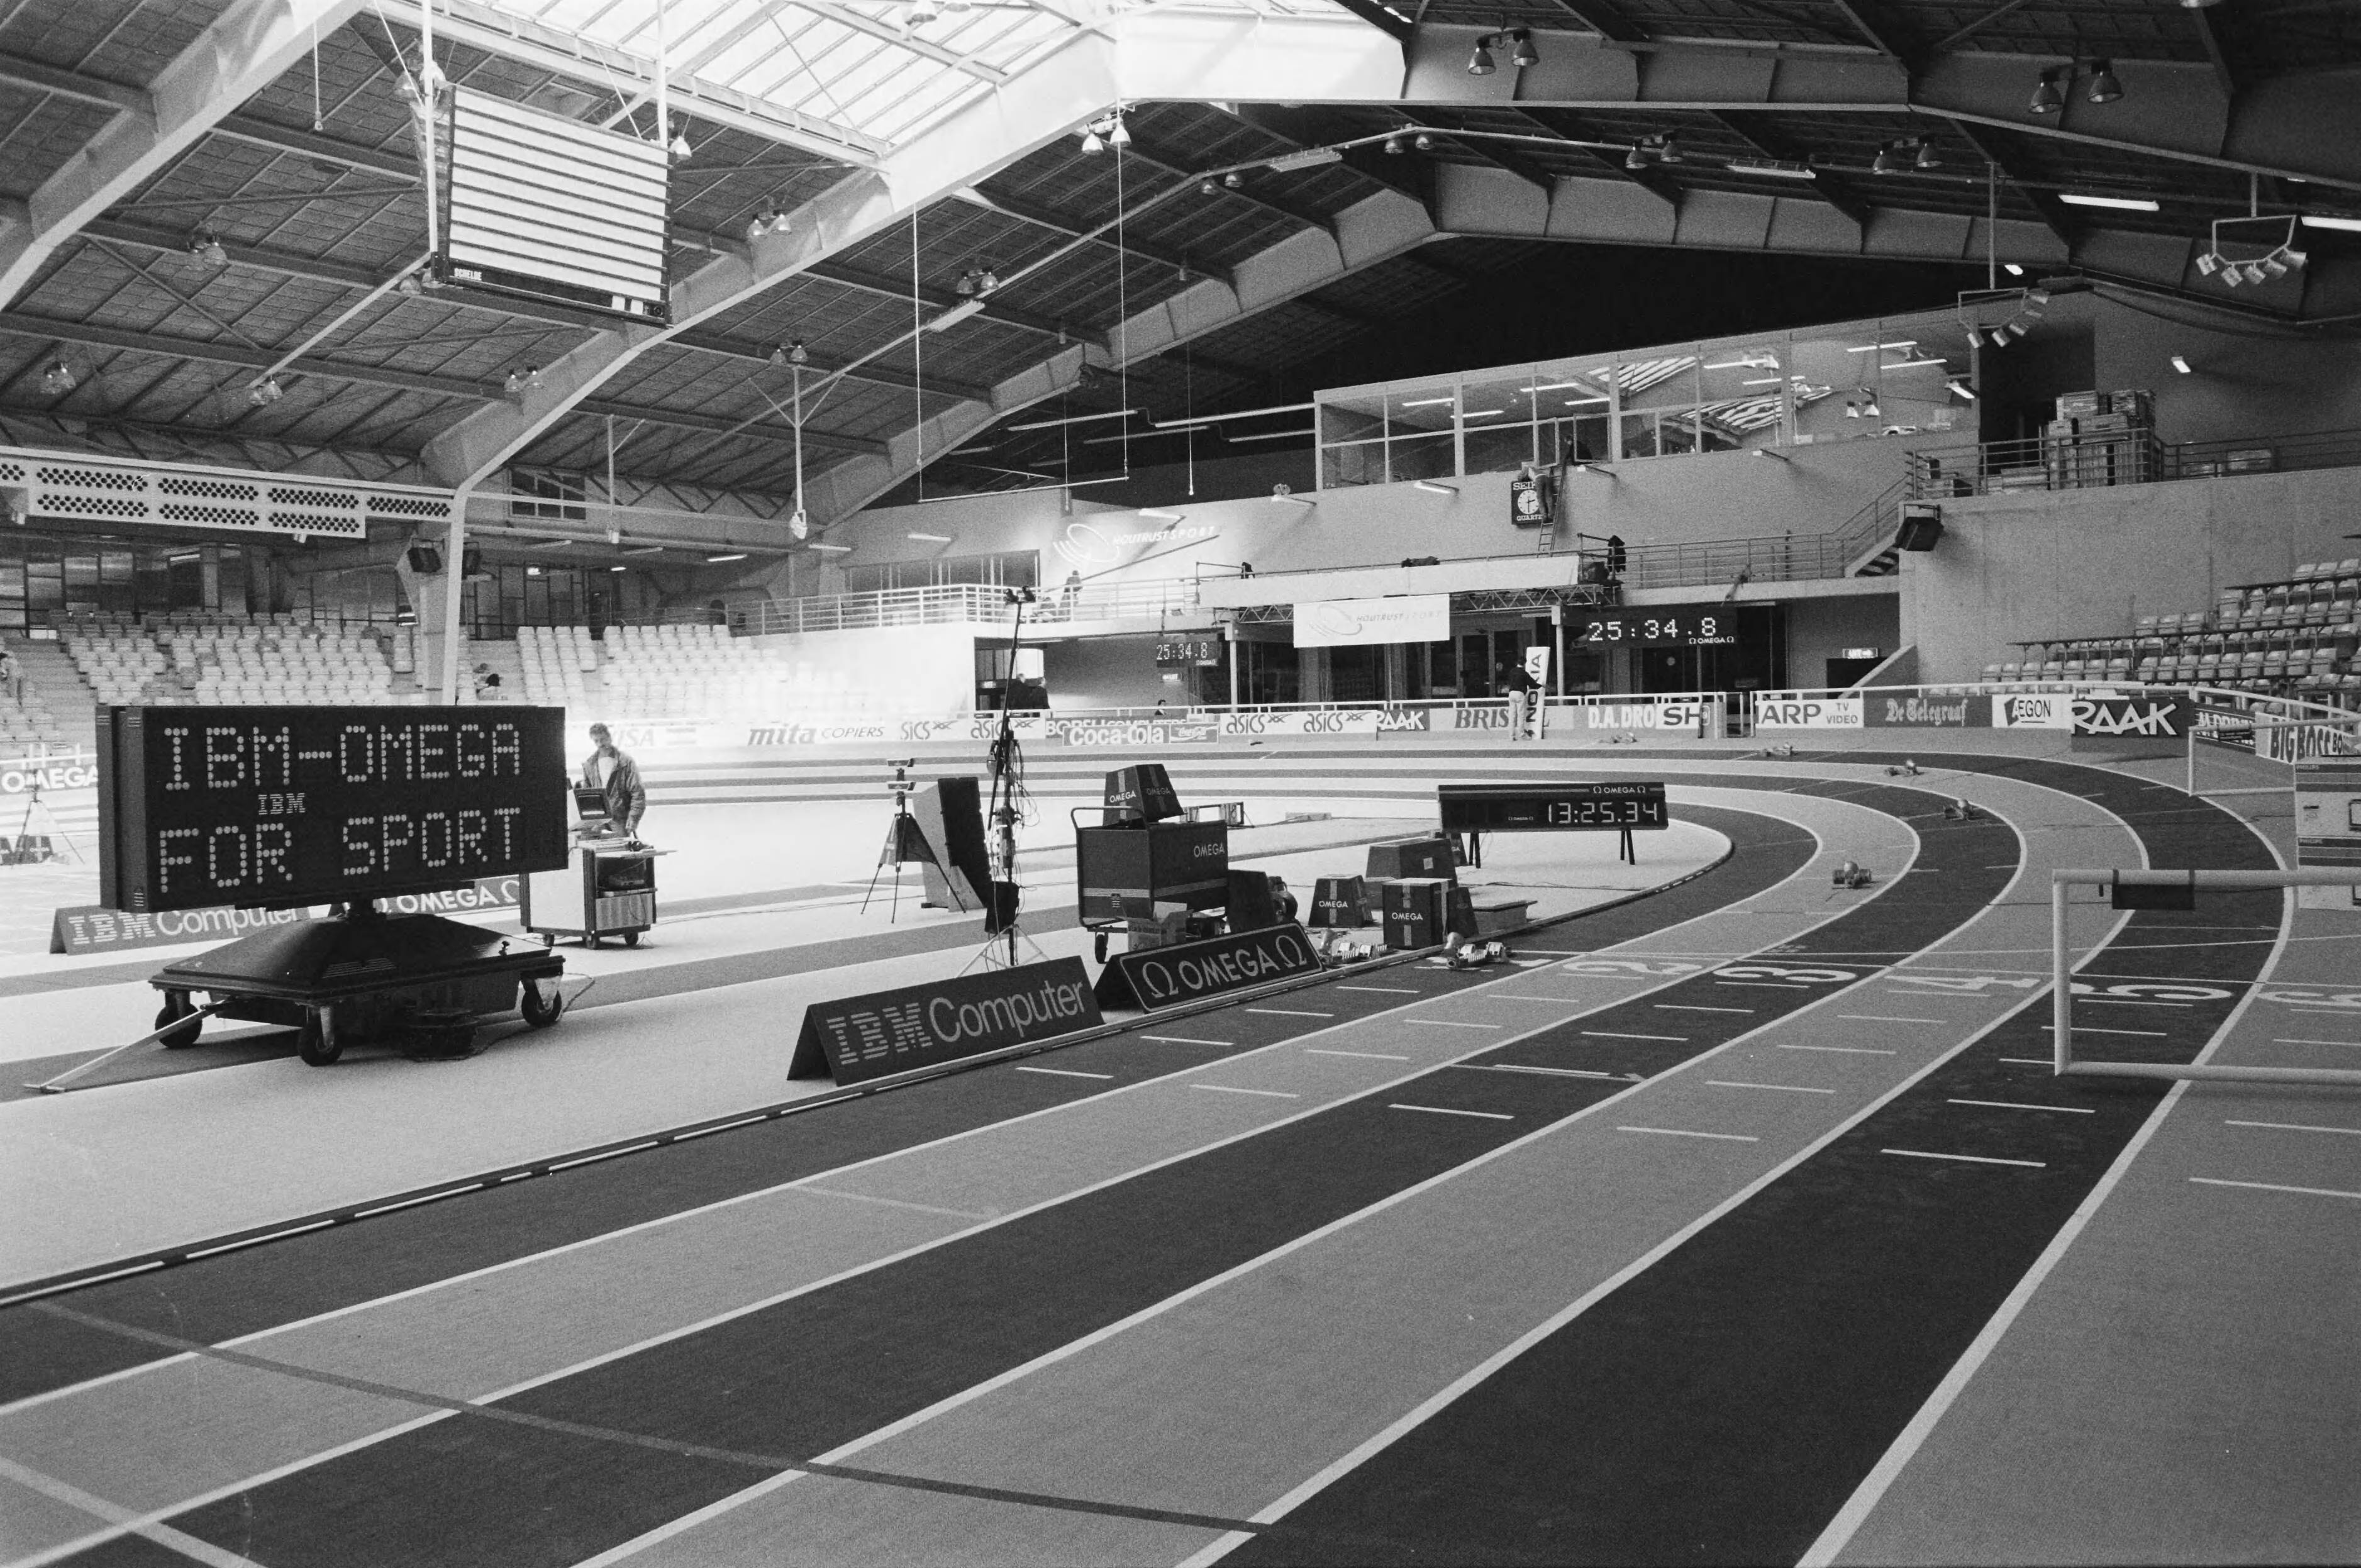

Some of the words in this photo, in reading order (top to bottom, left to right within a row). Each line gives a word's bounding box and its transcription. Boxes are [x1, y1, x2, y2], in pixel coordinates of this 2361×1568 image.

[1513, 481, 1536, 491] SEI
[1519, 653, 1542, 723] NOIA
[1836, 702, 1850, 711] TV
[1226, 714, 1265, 735] asics
[1303, 712, 1343, 733] asics
[1826, 714, 1858, 724] VIDEO
[2072, 701, 2177, 735] RAAK
[747, 723, 817, 746] mita
[821, 726, 886, 739] COPIERS
[899, 720, 930, 740] sics
[970, 720, 1009, 739] asic
[1069, 724, 1165, 746] Coca-Cola
[164, 723, 521, 791] IBM-OMEGA
[258, 792, 306, 816] IBM
[1109, 789, 1137, 803] OMEGA
[159, 823, 292, 894] FOR
[342, 807, 521, 876] SPORT
[1193, 842, 1225, 858] OMEGA
[396, 886, 499, 913] OMEGA
[1318, 900, 1349, 908] OMEGA
[1391, 911, 1423, 921] OMEGA
[67, 911, 156, 945] IBM
[1178, 944, 1281, 990] OMEGA
[826, 1002, 933, 1065] IBM
[928, 980, 1086, 1043] Computer
